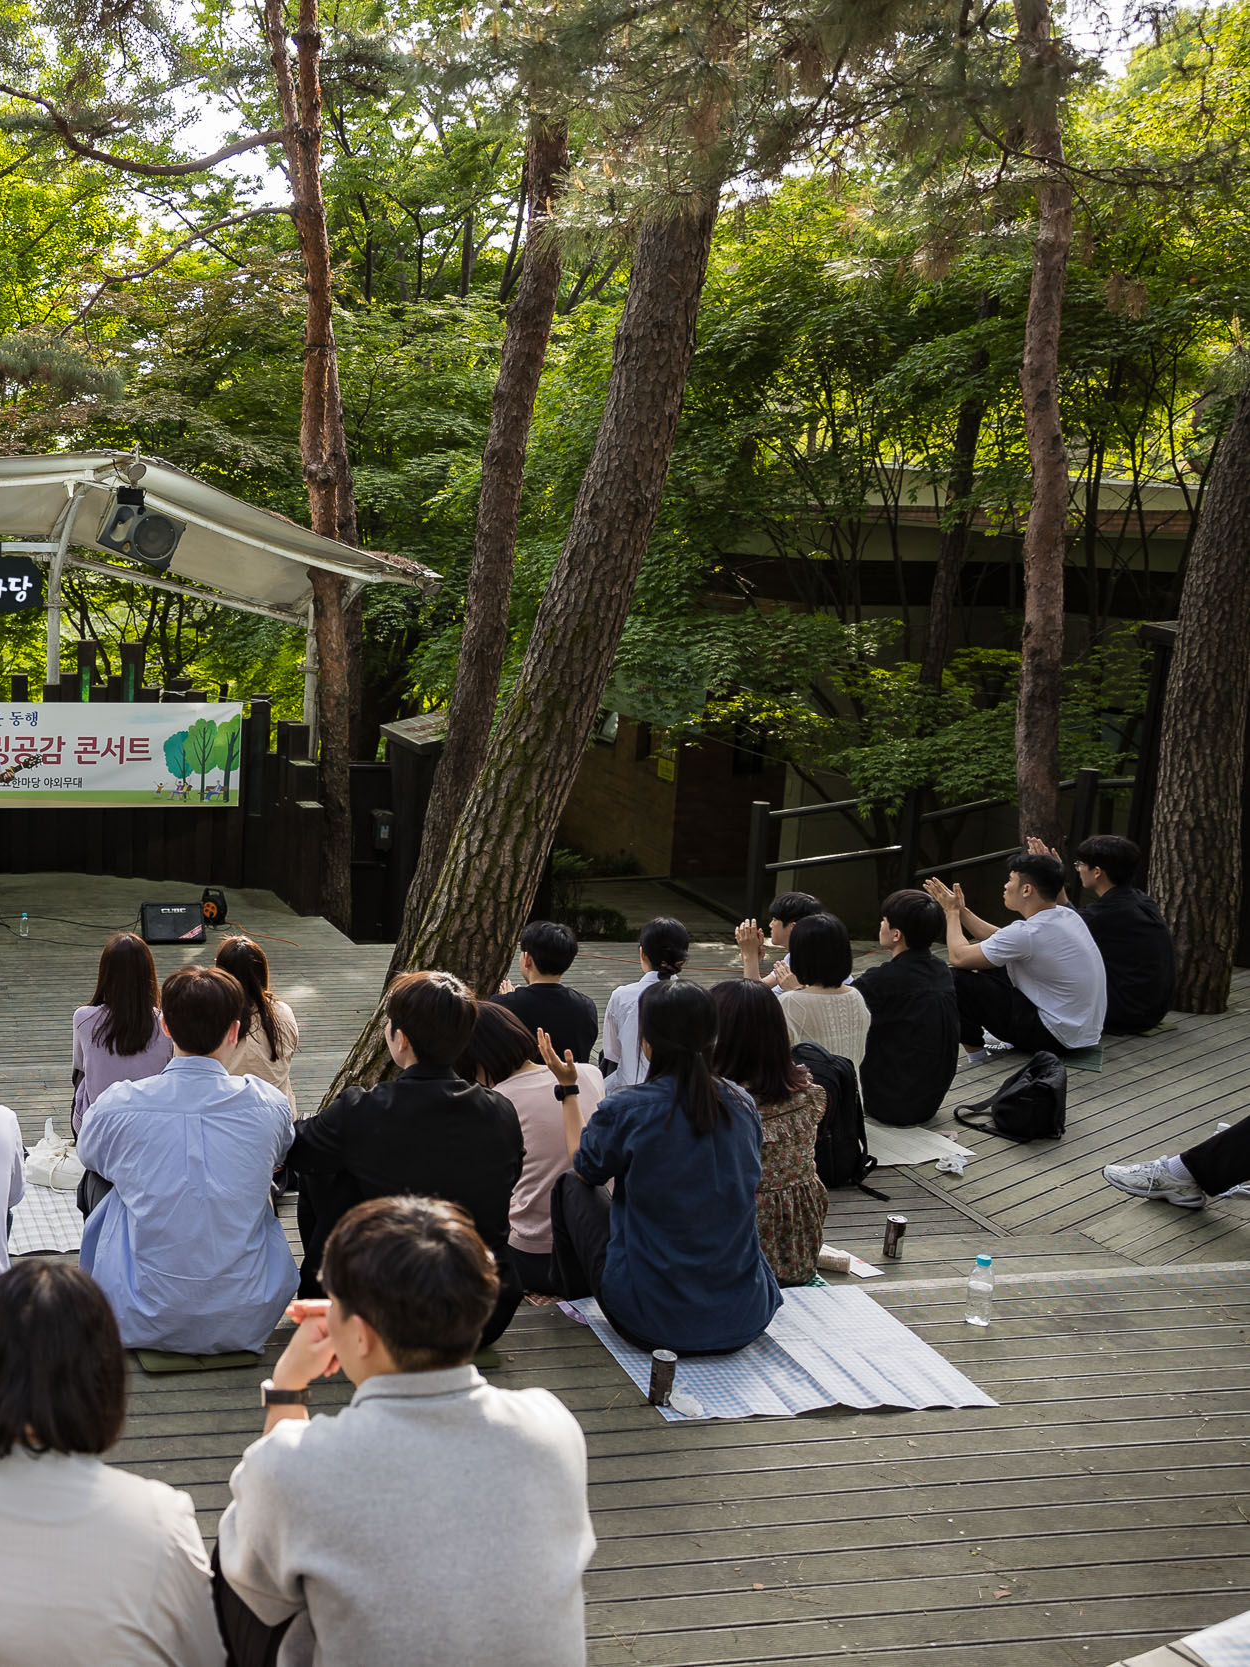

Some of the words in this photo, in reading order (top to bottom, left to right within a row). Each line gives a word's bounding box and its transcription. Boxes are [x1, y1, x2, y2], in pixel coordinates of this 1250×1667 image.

[9, 710, 39, 727] 동행
[73, 735, 153, 766] 콘서트
[43, 776, 83, 789] 야외무대
